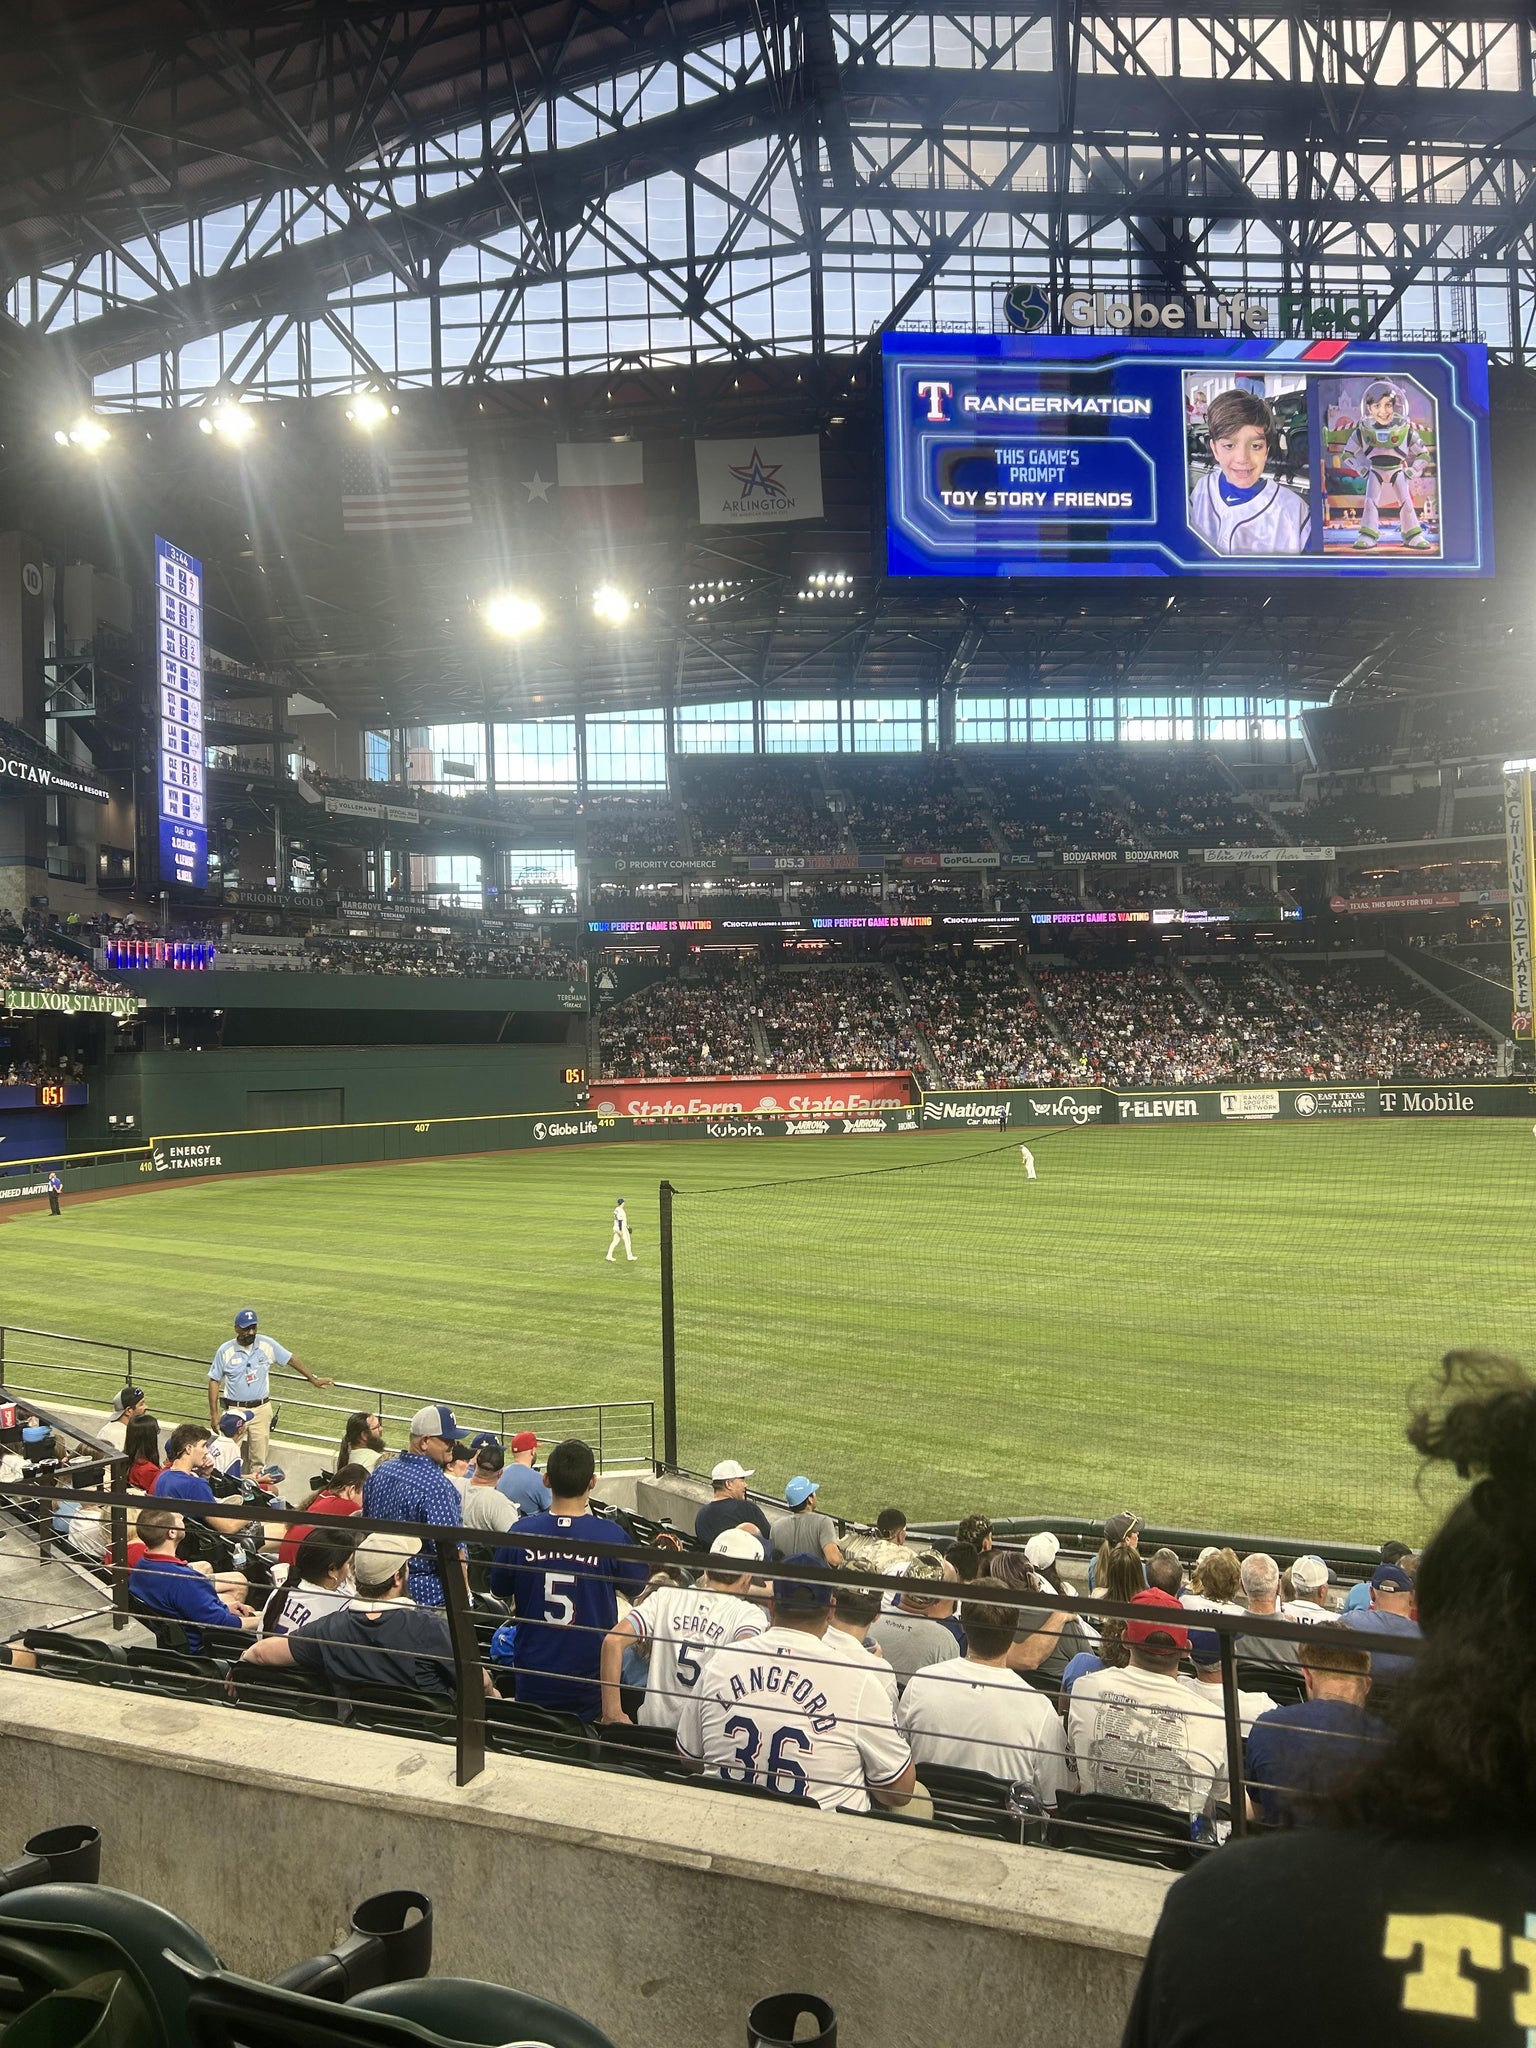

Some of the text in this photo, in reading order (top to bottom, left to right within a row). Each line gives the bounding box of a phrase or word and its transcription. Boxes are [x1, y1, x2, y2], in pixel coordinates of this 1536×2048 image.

[1063, 292, 1368, 332] Globe Life Field
[964, 396, 1151, 413] RANGERMATION
[995, 450, 1079, 466] THIS GAME'S
[1010, 468, 1065, 483] PROMPT
[722, 498, 796, 512] ARLINGTON
[941, 491, 1132, 506] TOY STORY FRIENDS
[170, 548, 188, 567] 3:44
[26, 568, 38, 590] 10
[51, 776, 78, 790] CASINOS
[79, 784, 84, 792] &
[84, 786, 110, 799] RESORTS
[174, 825, 194, 837] DUE UP
[1062, 851, 1117, 861] BODYARMOR
[1125, 850, 1179, 860] BODYARMOR
[1206, 849, 1235, 861] Blue
[1508, 805, 1524, 894] CHIKIN
[774, 858, 805, 868] 105.3
[913, 857, 937, 865] PGL
[943, 856, 996, 864] GoPGL.com
[1010, 855, 1035, 863] PGL
[240, 892, 324, 907] PRIORITY GOLD
[1350, 902, 1371, 910] TEXAS,
[1372, 901, 1386, 909] THIS
[1420, 898, 1433, 906] YOU
[342, 901, 426, 914] HARGROVE ROOFING
[812, 916, 932, 928] YOUR PERFECT GAME IS WAITING
[1031, 914, 1051, 924] YOUR
[1052, 914, 1084, 923] PERFECT
[1086, 913, 1107, 922] GAME
[1109, 913, 1116, 922] IS
[1118, 912, 1150, 922] WAITING
[1514, 902, 1526, 932] IZ
[588, 920, 711, 932] YOUR PERFECT GAME IS WAITING
[1515, 941, 1528, 1003] FARE
[20, 991, 135, 1013] LUXOR STAFFING
[1380, 1092, 1474, 1112] T Mobile
[1053, 1096, 1102, 1124] Kroger
[414, 1123, 430, 1133] 407
[548, 1121, 598, 1137] Globe Life
[598, 1119, 615, 1127] 410
[796, 1120, 824, 1129] ARROW
[853, 1118, 880, 1127] ARROW
[707, 1123, 763, 1138] Kubota
[170, 1145, 211, 1157] ENERGY
[139, 1161, 153, 1172] 410
[171, 1157, 222, 1169] TRANSFER
[22, 1185, 48, 1196] MARTIN
[245, 1311, 254, 1320] T
[544, 1572, 577, 1625] 5
[673, 1615, 725, 1640] SEAGER
[677, 1640, 705, 1687] 5
[714, 1666, 838, 1735] LANGFORD
[720, 1715, 813, 1797] 36
